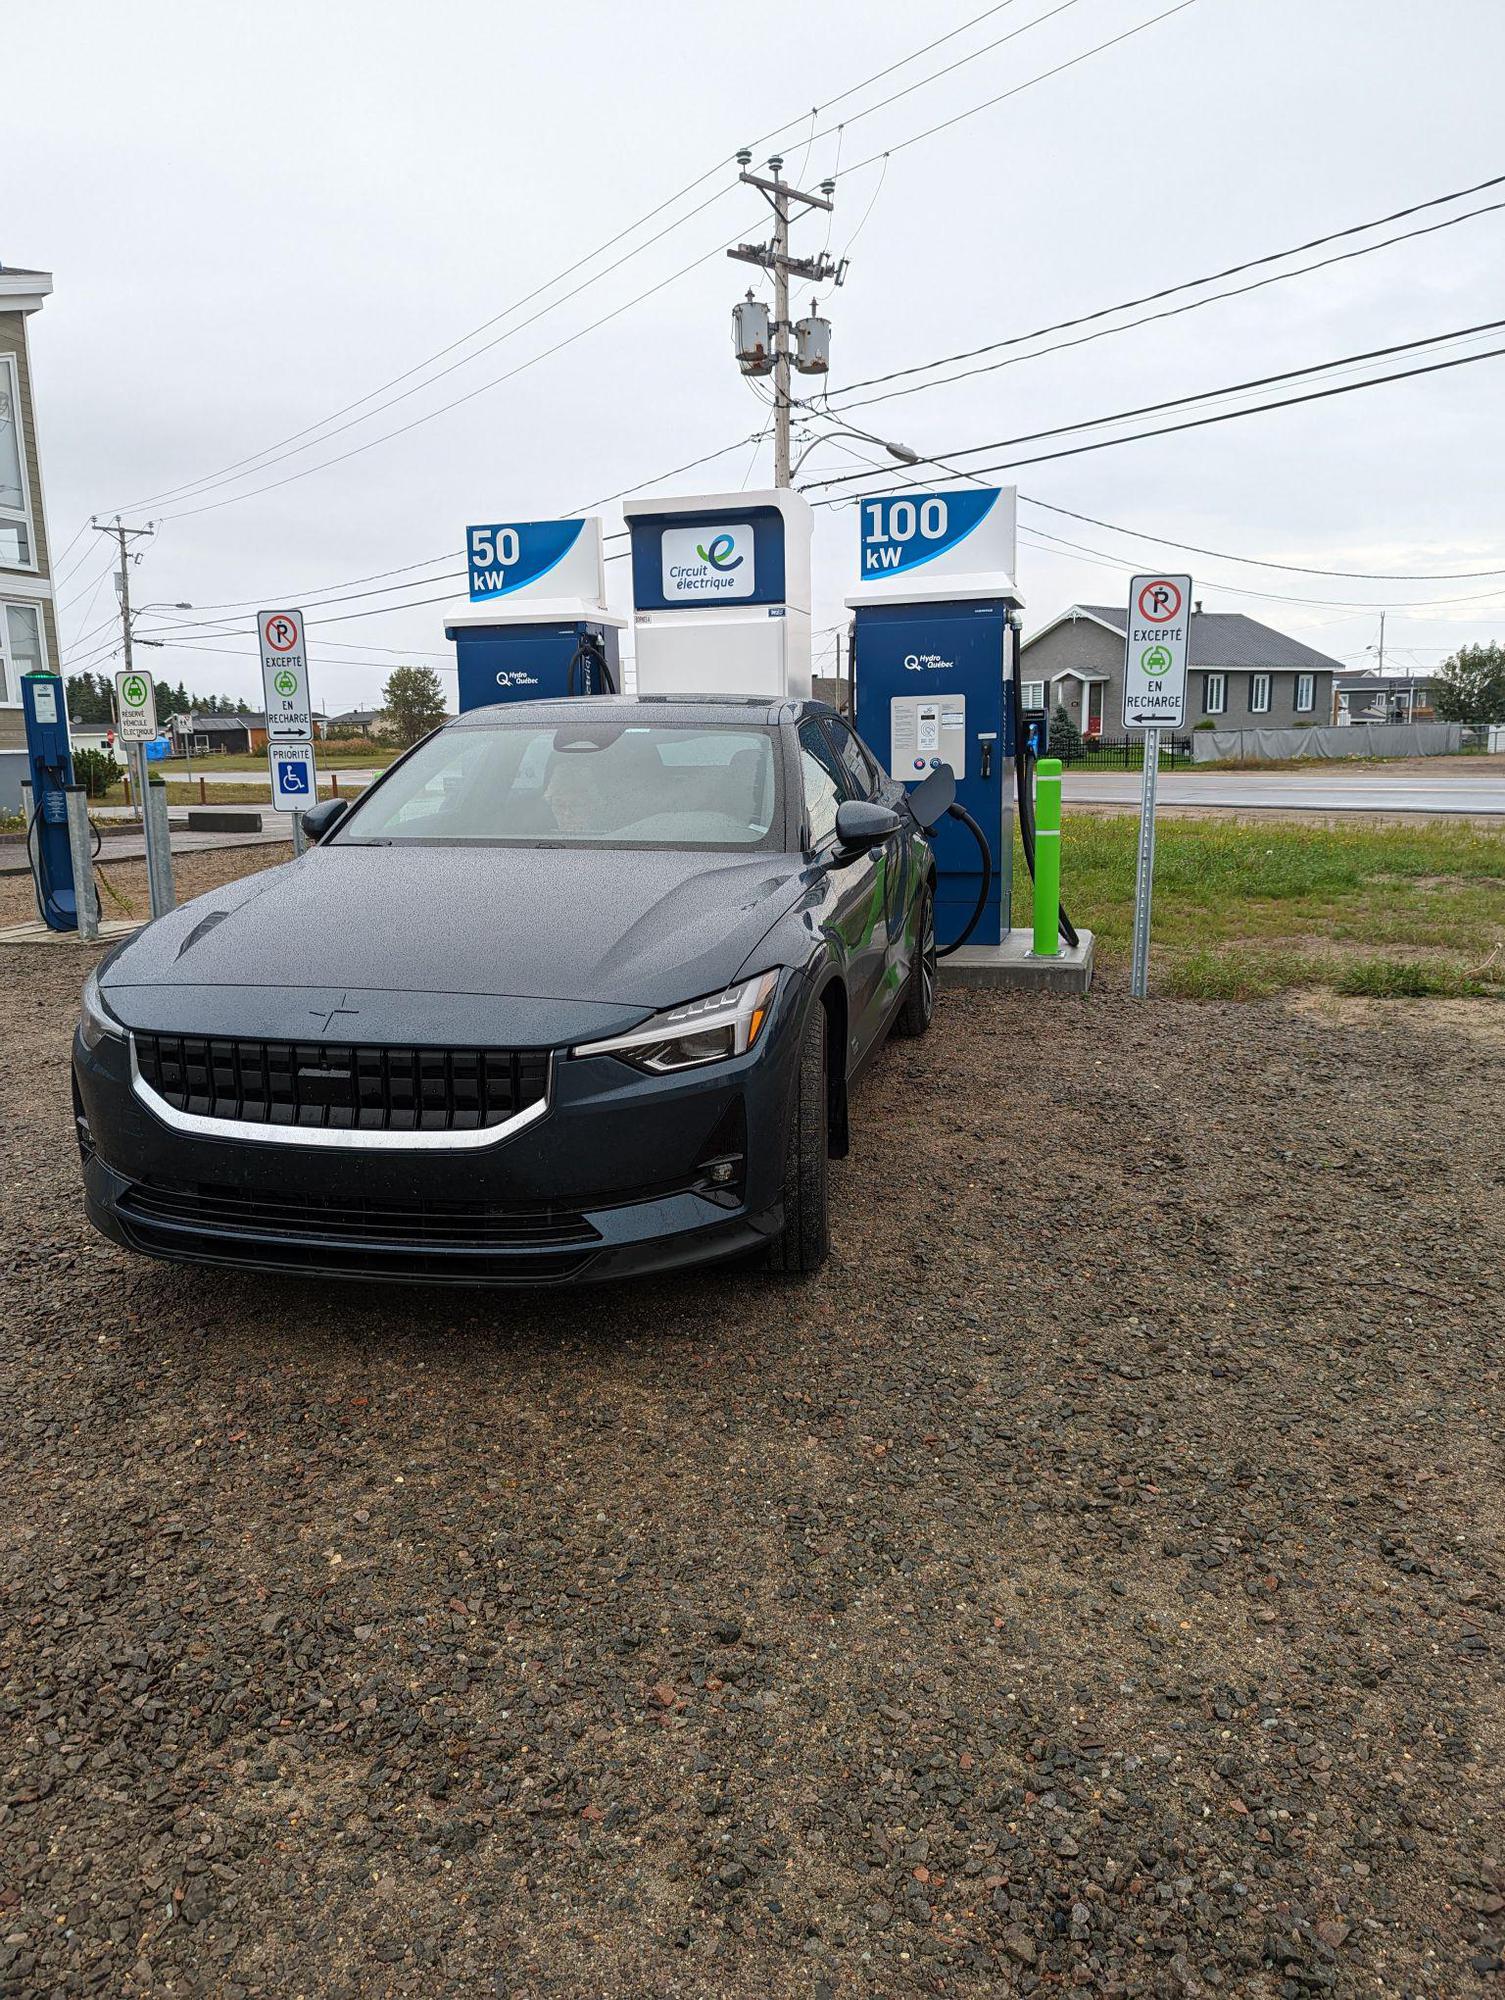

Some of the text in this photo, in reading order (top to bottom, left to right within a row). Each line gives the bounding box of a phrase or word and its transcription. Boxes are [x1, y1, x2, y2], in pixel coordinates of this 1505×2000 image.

[866, 498, 948, 543] 100
[472, 528, 520, 567] 50
[866, 546, 903, 569] kW
[669, 565, 708, 578] Circuit
[473, 570, 504, 591] kW
[676, 576, 735, 591] électrique
[1133, 628, 1183, 642] EXCEPTÉ
[265, 656, 303, 668] EXCEPTÉ
[919, 654, 941, 663] Hydro
[927, 660, 954, 669] Québec
[509, 671, 528, 680] Hydro
[515, 676, 539, 685] Québec
[1148, 680, 1163, 692] EN
[282, 700, 294, 711] EN
[1127, 696, 1181, 708] RECHARGE
[268, 713, 309, 724] RECHARGE
[273, 747, 310, 760] PRIORITÉ
